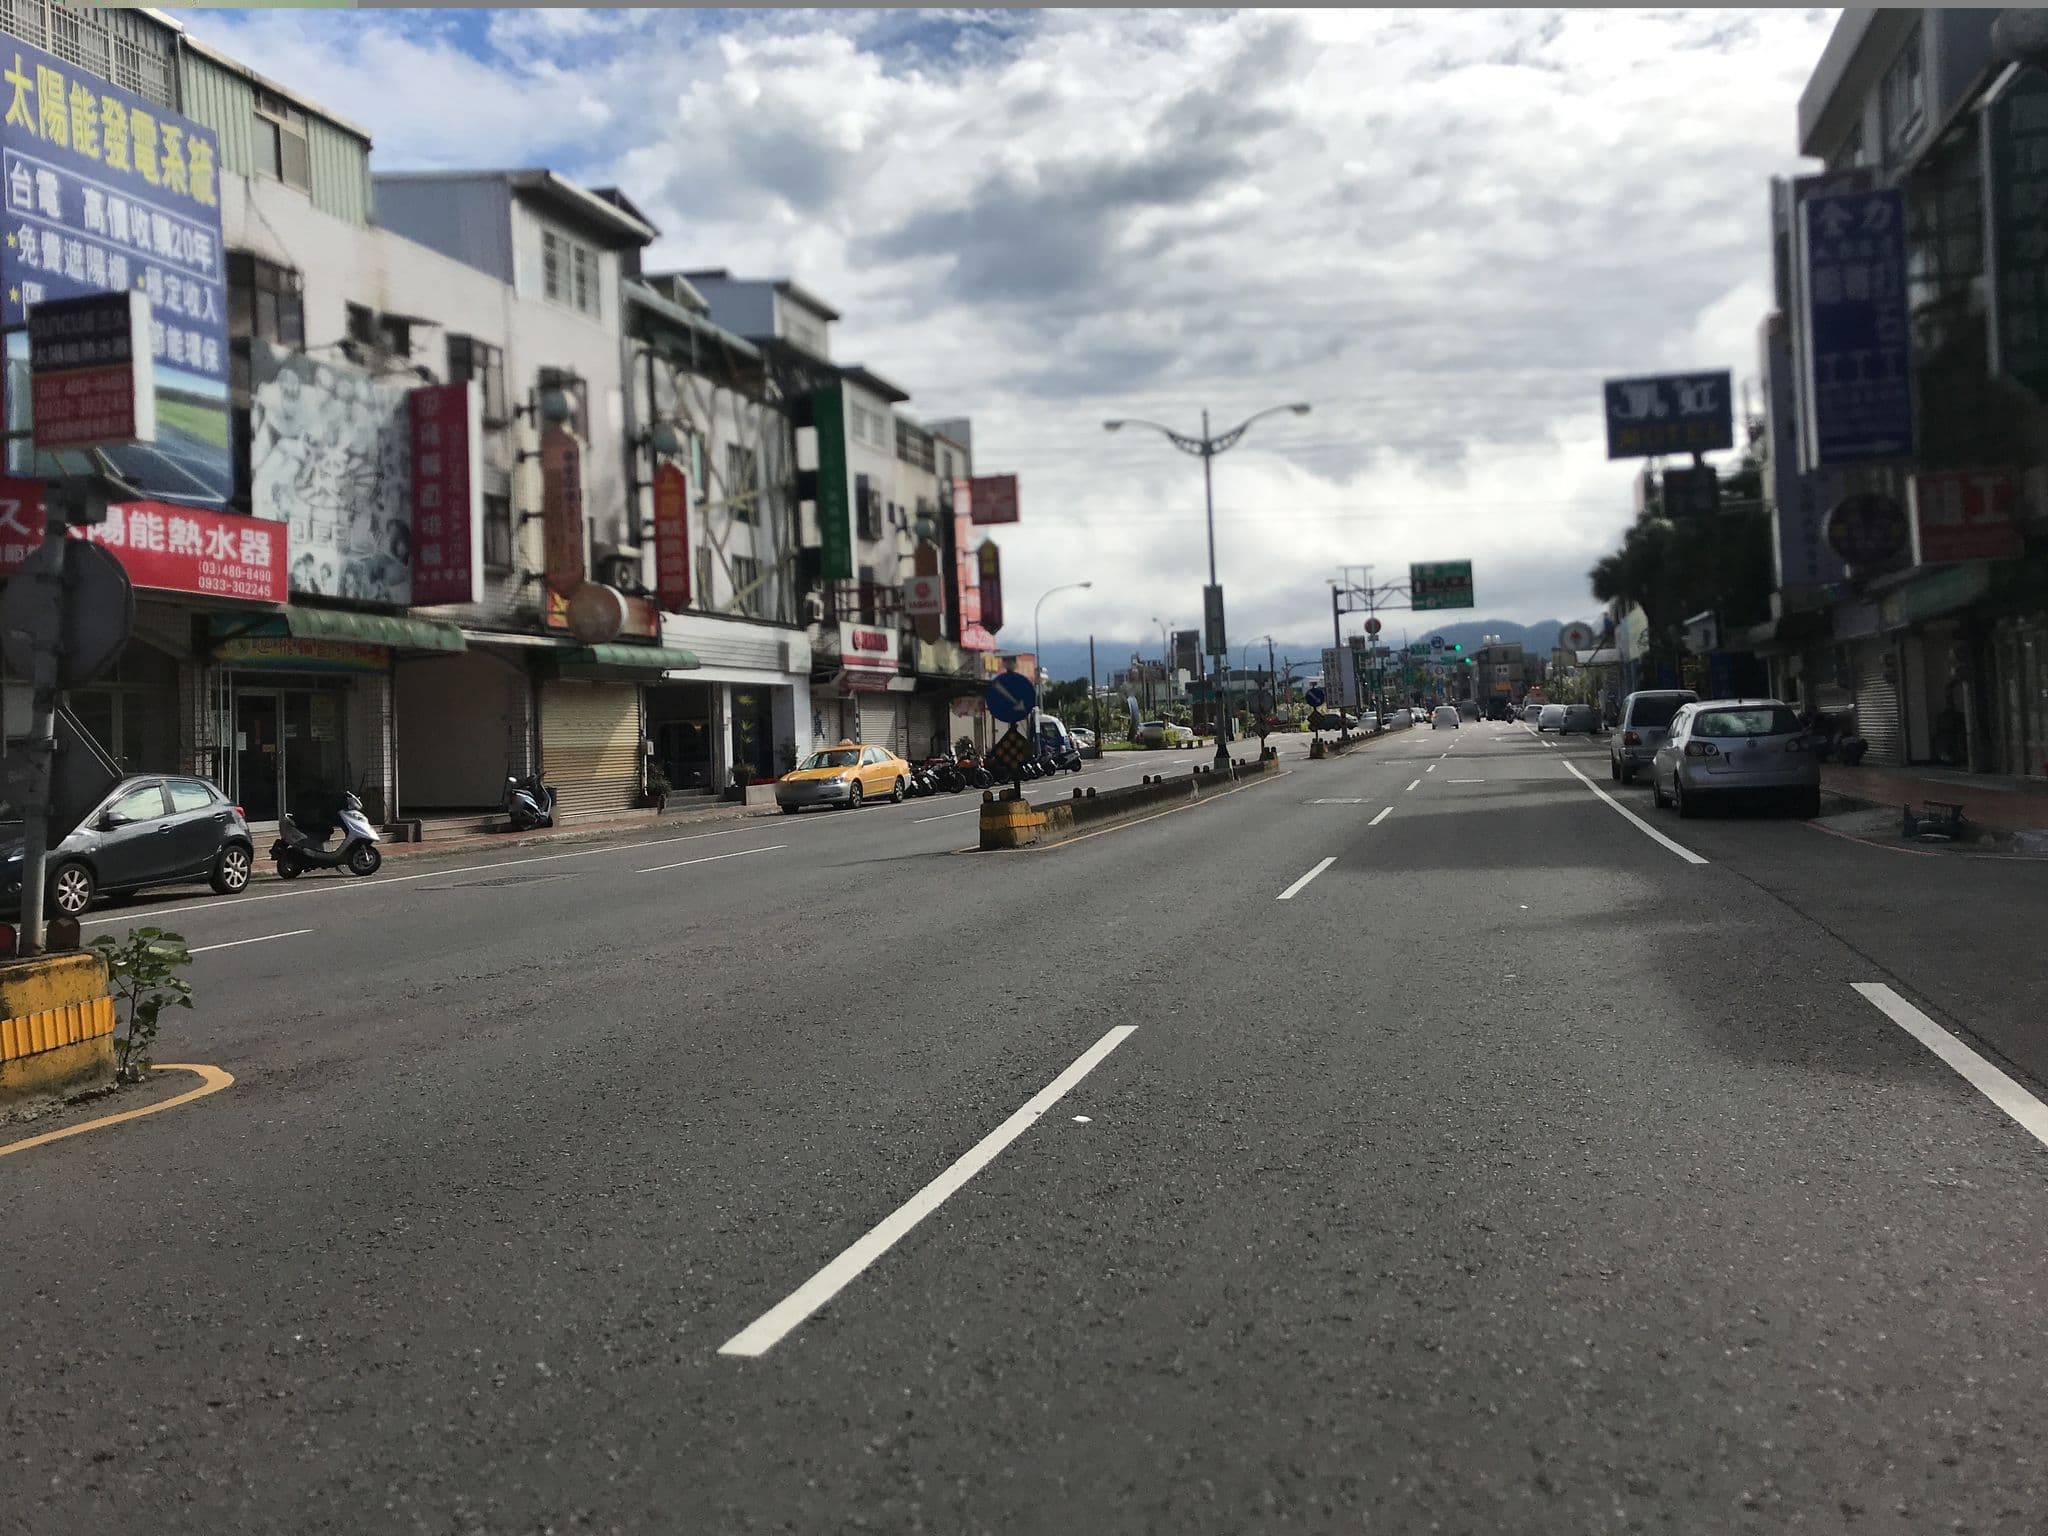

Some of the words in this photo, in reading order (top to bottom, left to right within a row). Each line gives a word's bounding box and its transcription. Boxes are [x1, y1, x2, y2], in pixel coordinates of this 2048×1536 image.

[4, 53, 216, 206] 太陽能發電系統
[10, 160, 61, 219] 台電
